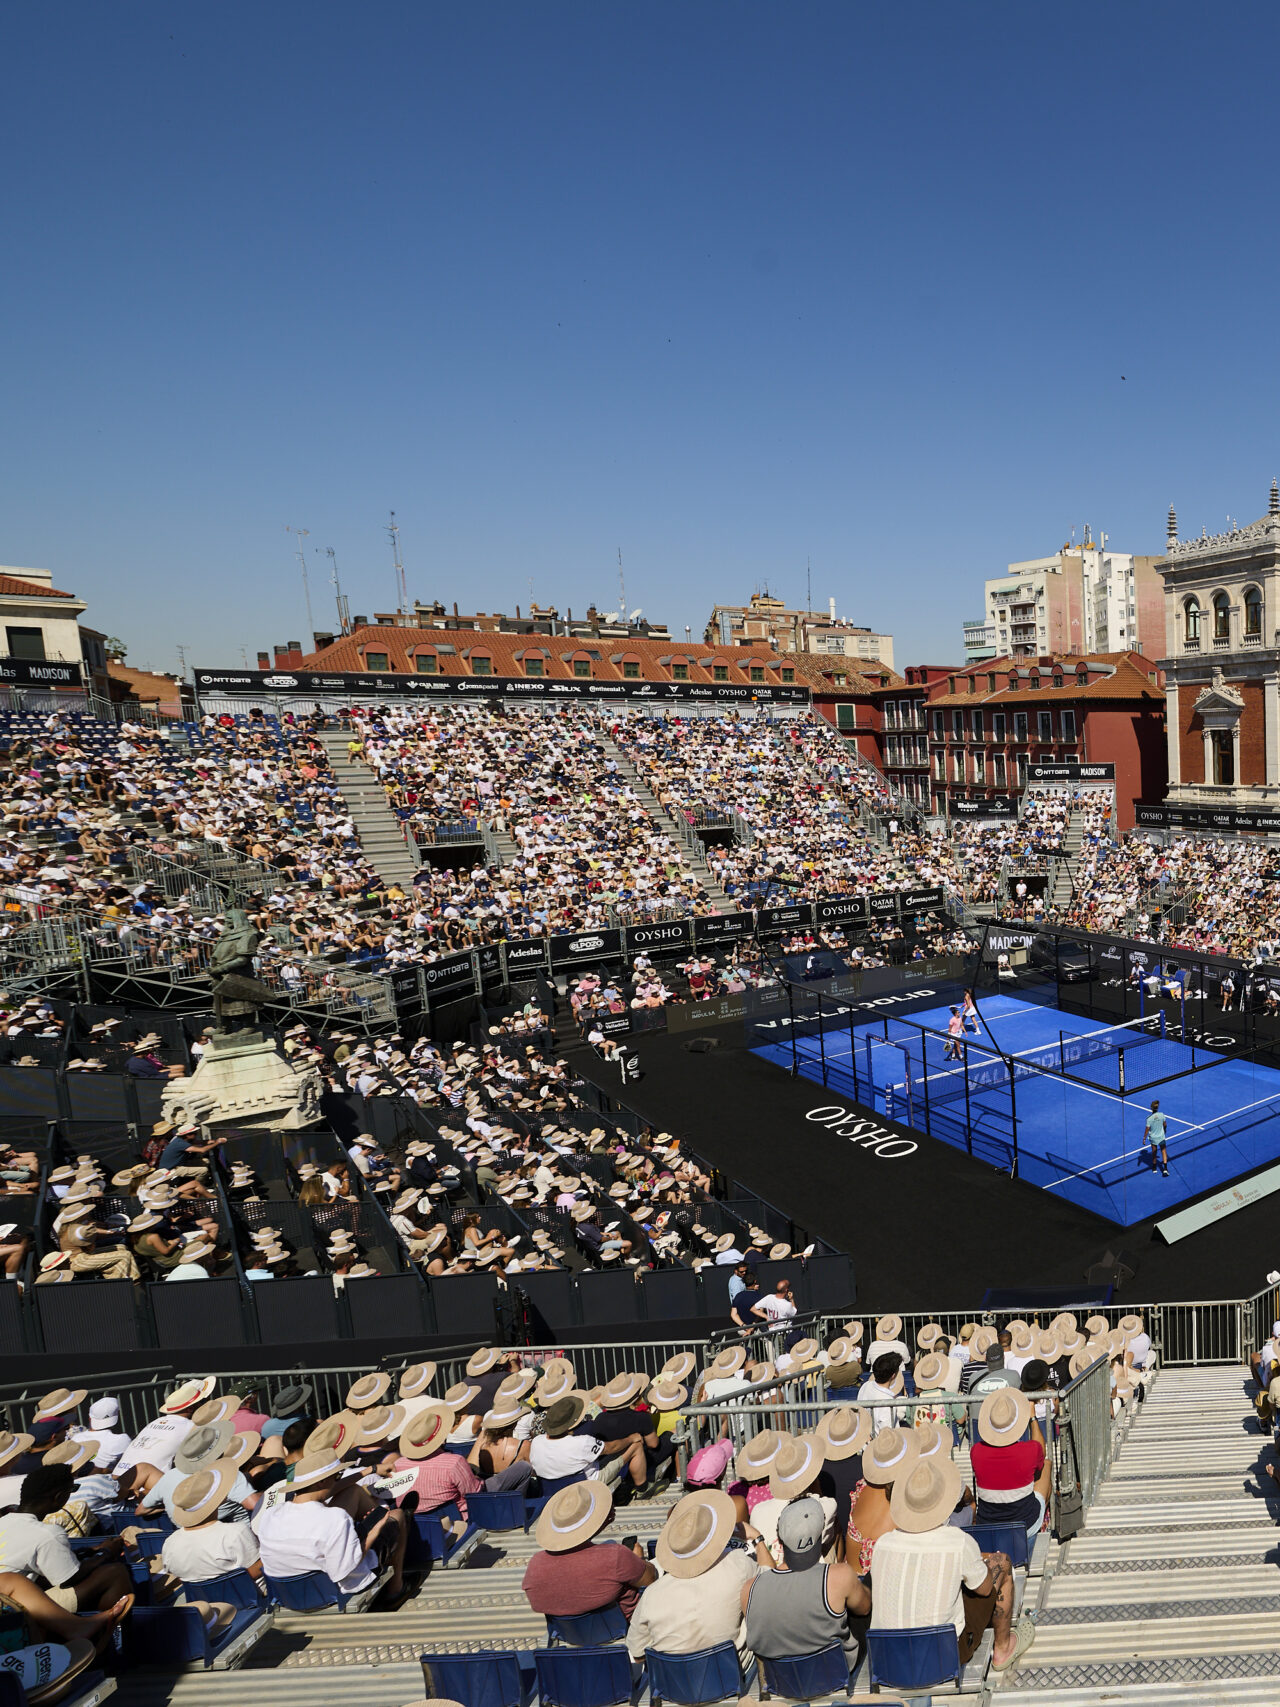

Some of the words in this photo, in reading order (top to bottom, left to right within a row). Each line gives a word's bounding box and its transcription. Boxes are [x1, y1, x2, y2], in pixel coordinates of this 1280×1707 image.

[28, 666, 70, 680] MADISON
[1080, 768, 1106, 776] MADISON
[1140, 812, 1163, 820] OYSHO
[871, 898, 894, 907] QATAR
[822, 904, 860, 916] OYSHO
[634, 927, 682, 942] OYSHO
[989, 936, 1033, 950] MADISON
[509, 948, 543, 958] Adeslas
[437, 968, 451, 978] NTT
[605, 1021, 629, 1029] Valladolid
[805, 1106, 918, 1158] OYSHO
[375, 1473, 414, 1495] greenset
[797, 1537, 814, 1549] LA
